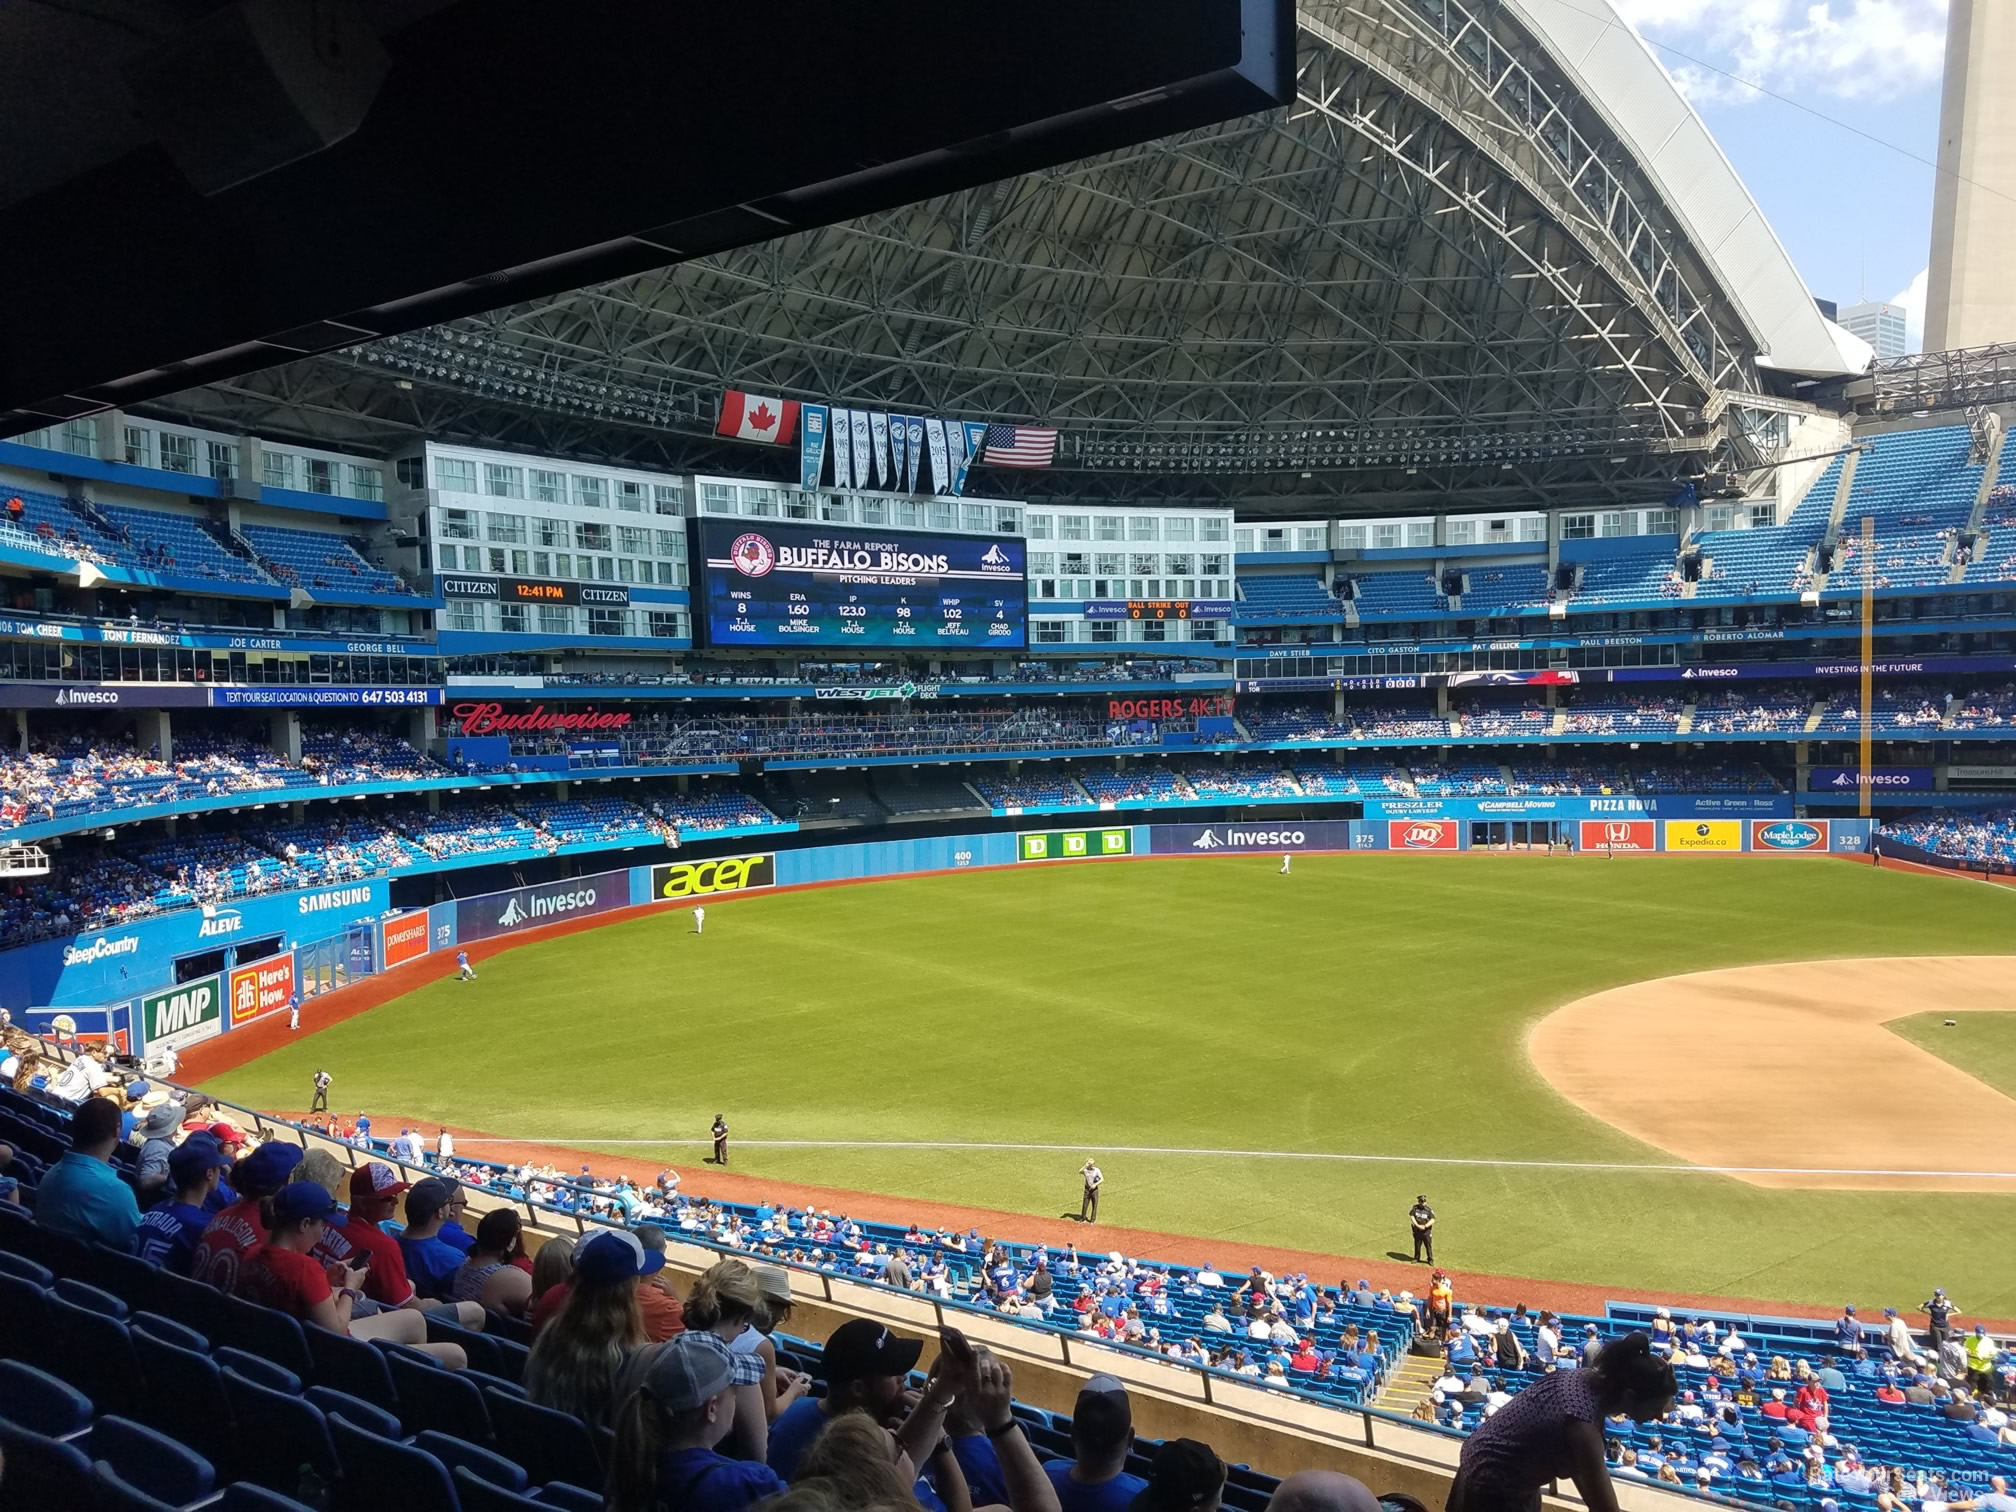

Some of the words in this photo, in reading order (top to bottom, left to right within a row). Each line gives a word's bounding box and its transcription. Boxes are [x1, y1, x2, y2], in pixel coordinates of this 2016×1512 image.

[876, 441, 887, 451] 199
[894, 442, 904, 453] 199
[909, 445, 919, 456] 199
[813, 539, 831, 549] THE
[834, 540, 860, 550] FARM
[864, 541, 899, 552] REPORT
[779, 546, 871, 570] BUFFALO
[880, 550, 948, 573] BISONS
[981, 563, 1010, 573] Invesco
[839, 574, 878, 584] PITCHING
[880, 576, 916, 586] LEADERS
[444, 580, 497, 595] CITIZEN
[517, 584, 544, 597] 12:41
[546, 586, 564, 598] PM
[582, 588, 628, 602] CITIZEN
[730, 591, 752, 600] WINS
[790, 593, 806, 602] ERA
[942, 598, 960, 606] WHIP
[994, 599, 1004, 607] SV
[737, 602, 747, 614] 8
[787, 604, 810, 616] 1.60
[838, 606, 866, 617] 123.0
[896, 607, 911, 618] 98
[1098, 606, 1127, 614] Invesco
[1203, 605, 1231, 613] Invesco
[943, 609, 962, 619] 1.02
[996, 610, 1004, 620] 4
[1133, 609, 1140, 619] 0
[1157, 609, 1164, 619] 0
[1179, 609, 1187, 619] 0
[790, 618, 809, 627] MIKE
[945, 622, 961, 630] JEFF
[15, 622, 35, 635] TOM
[36, 623, 64, 637] CHEEK
[729, 624, 756, 633] HOUSE
[778, 625, 820, 634] BOLSINGER
[841, 626, 865, 635] HOUSE
[893, 627, 916, 636] HOUSE
[937, 628, 969, 636] BELIVEAU
[102, 629, 127, 641] TONY
[131, 631, 180, 645] FERNANDEZ
[1580, 638, 1601, 646] PAUL
[1604, 637, 1642, 645] BEESTON
[1703, 632, 1744, 641] ROBERTO
[1747, 631, 1785, 640] ALOMAR
[229, 637, 246, 648] JOE
[250, 638, 281, 649] CARTER
[347, 642, 383, 653] GEORGE
[386, 643, 406, 653] BELL
[1698, 666, 1738, 677] Invesco
[1815, 664, 1859, 675] INVESTING
[1871, 664, 1887, 673] THE
[1889, 662, 1923, 672] FUTURE
[816, 686, 902, 701] WESTJET
[917, 684, 941, 693] FLIGHT
[69, 688, 119, 704] Invesco
[226, 692, 241, 703] TEXT
[240, 692, 261, 703] YOUR
[261, 692, 277, 703] SEAT
[276, 692, 308, 703] LOCATION
[308, 692, 314, 703] &
[313, 692, 349, 704] QUESTION
[349, 692, 359, 702] TO
[362, 691, 383, 703] 647
[384, 691, 405, 703] 503
[406, 691, 428, 703] 4131
[920, 692, 938, 700] DECK
[1108, 699, 1183, 719] ROGERS
[1188, 697, 1210, 717] 4K
[452, 702, 633, 735] Budweiser
[1855, 773, 1911, 785] Invesco
[1381, 801, 1443, 810] PRESZLER
[1484, 801, 1525, 810] CAMPBELL
[1524, 801, 1556, 809] MOVING
[1589, 799, 1625, 812] PIZZA
[1628, 798, 1658, 812] NOVA
[1695, 799, 1721, 807] Active
[1724, 799, 1747, 807] Green
[1754, 799, 1774, 807] Ross
[1227, 828, 1305, 846] Invesco
[1355, 834, 1375, 843] 375
[1410, 828, 1437, 843] DQ
[1839, 835, 1861, 845] 328
[1026, 838, 1045, 854] TD
[1064, 836, 1085, 852] TD
[1103, 834, 1124, 850] TD
[1679, 837, 1727, 848] Expedia.ca
[954, 850, 972, 861] 400
[663, 855, 765, 899] acer
[299, 886, 371, 914] SAMSUNG
[530, 887, 597, 918] Invesco
[198, 915, 243, 938] ALEVE
[436, 924, 451, 940] 375
[258, 964, 290, 988] Here's
[259, 990, 285, 1008] How.
[154, 986, 212, 1038] MNP
[143, 1211, 183, 1239] STRADA
[205, 1215, 258, 1248] NALDSON
[1001, 1276, 1010, 1288] 6
[1453, 1340, 1463, 1351] 2
